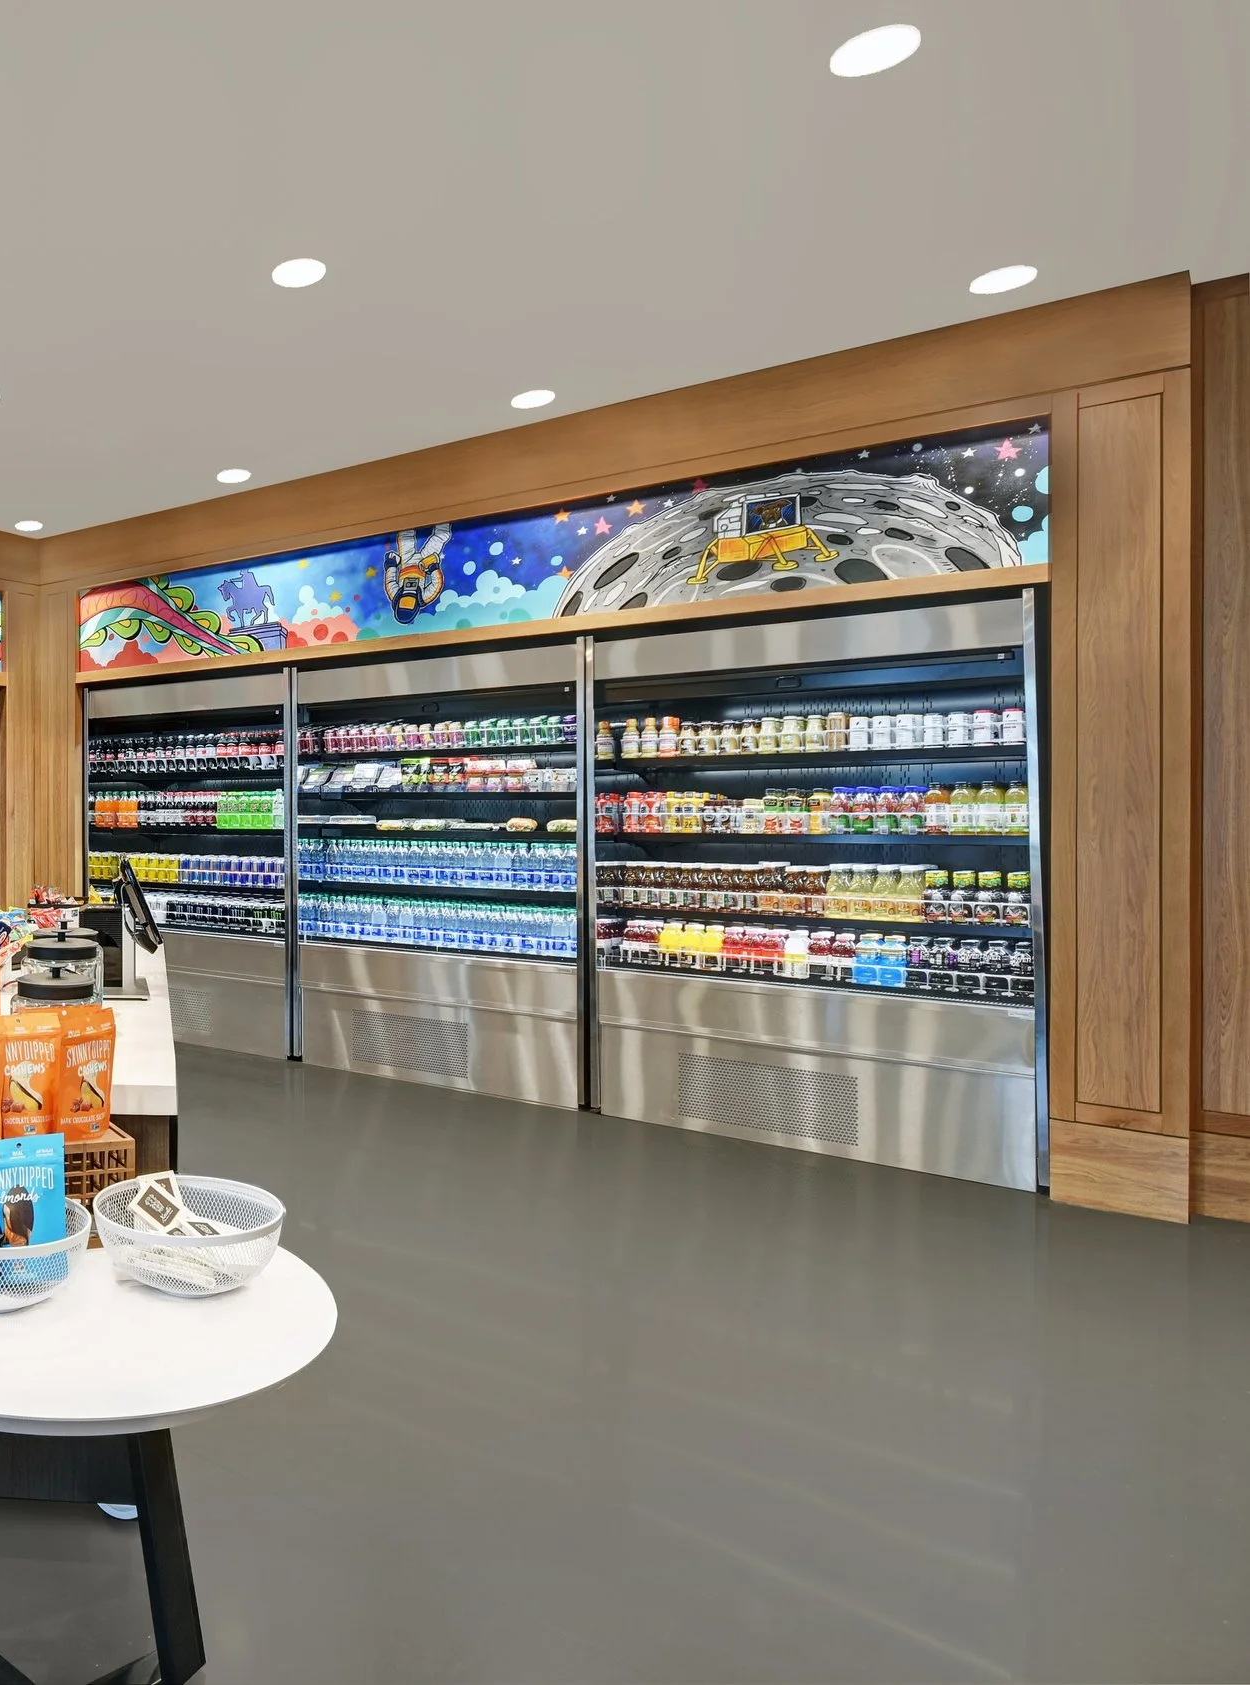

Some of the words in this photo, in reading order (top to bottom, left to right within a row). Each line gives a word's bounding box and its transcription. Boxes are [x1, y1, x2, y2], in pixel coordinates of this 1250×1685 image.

[5, 1041, 55, 1062] NNYDIPPED
[4, 1062, 46, 1076] CASHEWS
[77, 1060, 108, 1076] CASHEWS
[72, 1115, 96, 1123] CHOCOLATE
